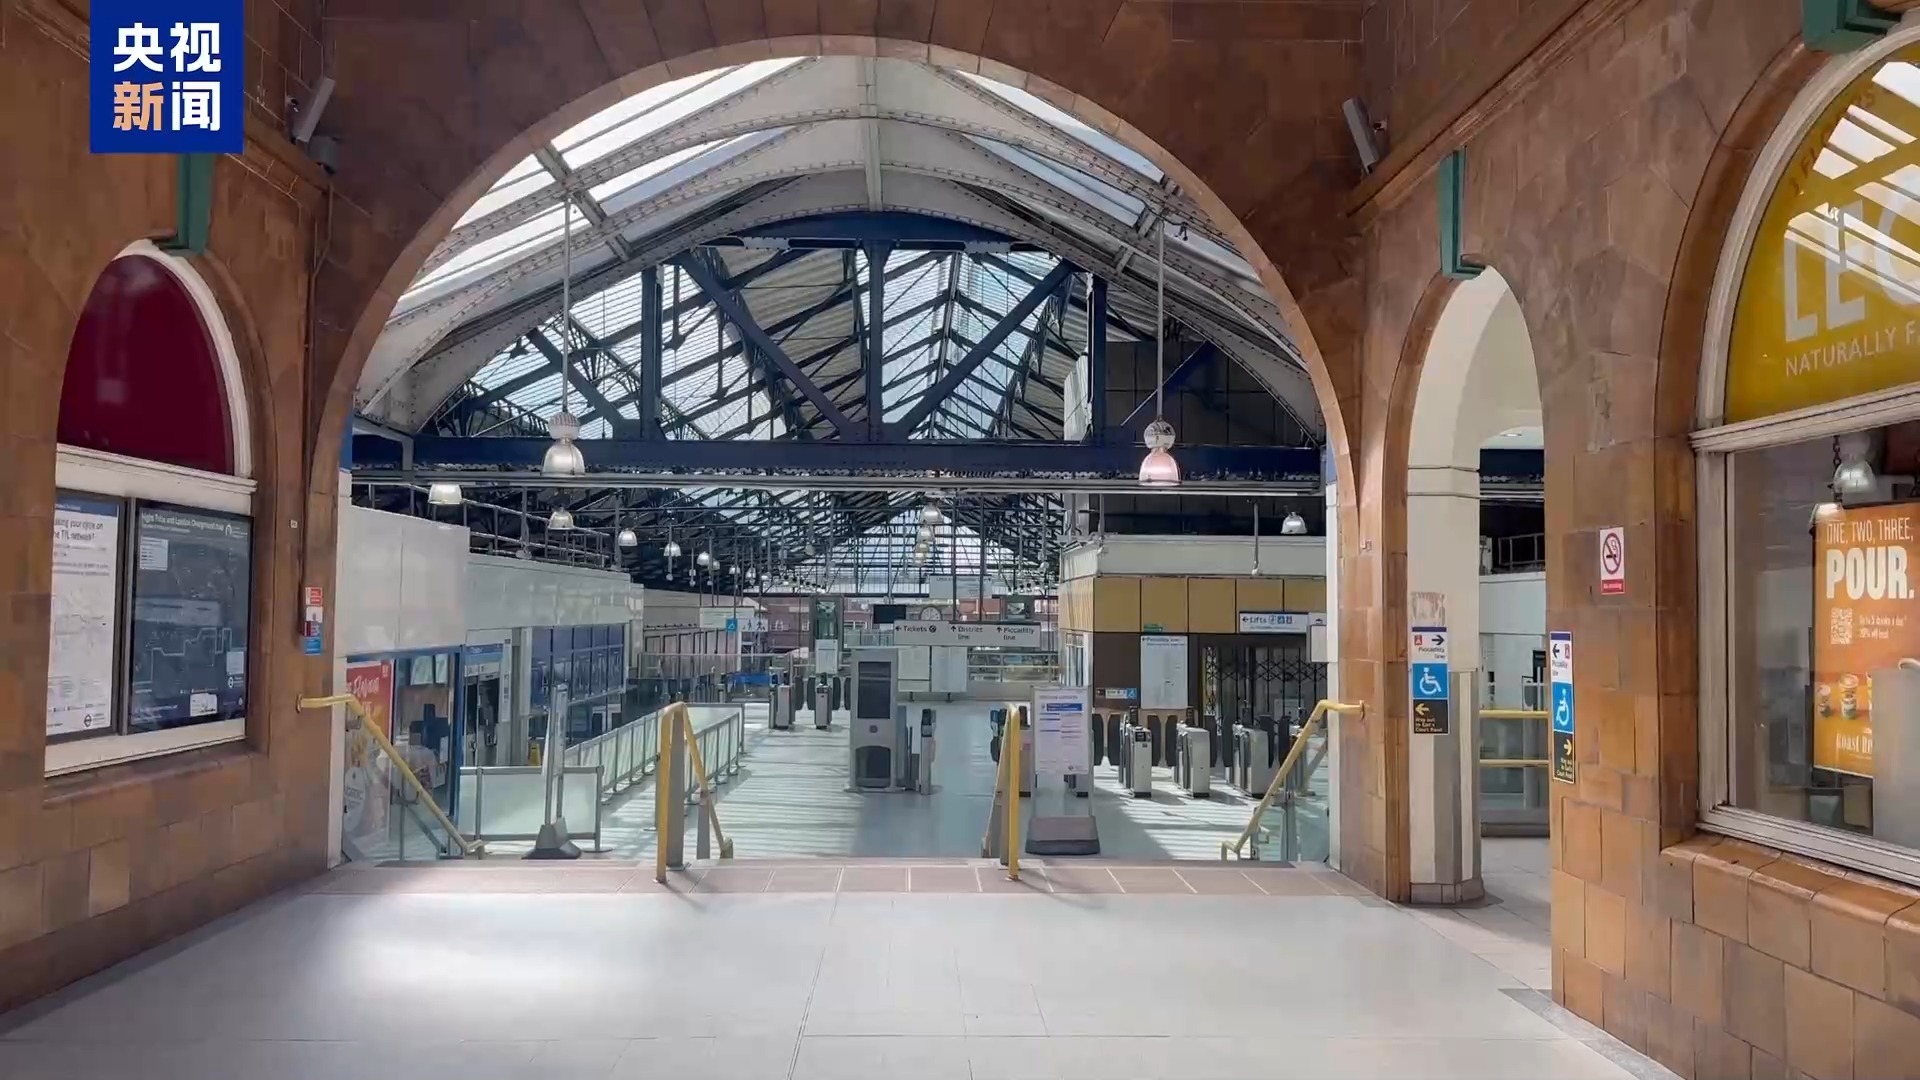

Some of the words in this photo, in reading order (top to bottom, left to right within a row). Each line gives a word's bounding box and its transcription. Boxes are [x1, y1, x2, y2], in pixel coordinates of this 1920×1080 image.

[1786, 327, 1896, 376] NATURALLY
[1851, 520, 1876, 545] TWO,
[1877, 516, 1914, 542] THREE,
[1826, 545, 1915, 600] POUR.
[1003, 627, 1035, 635] Piccadilly
